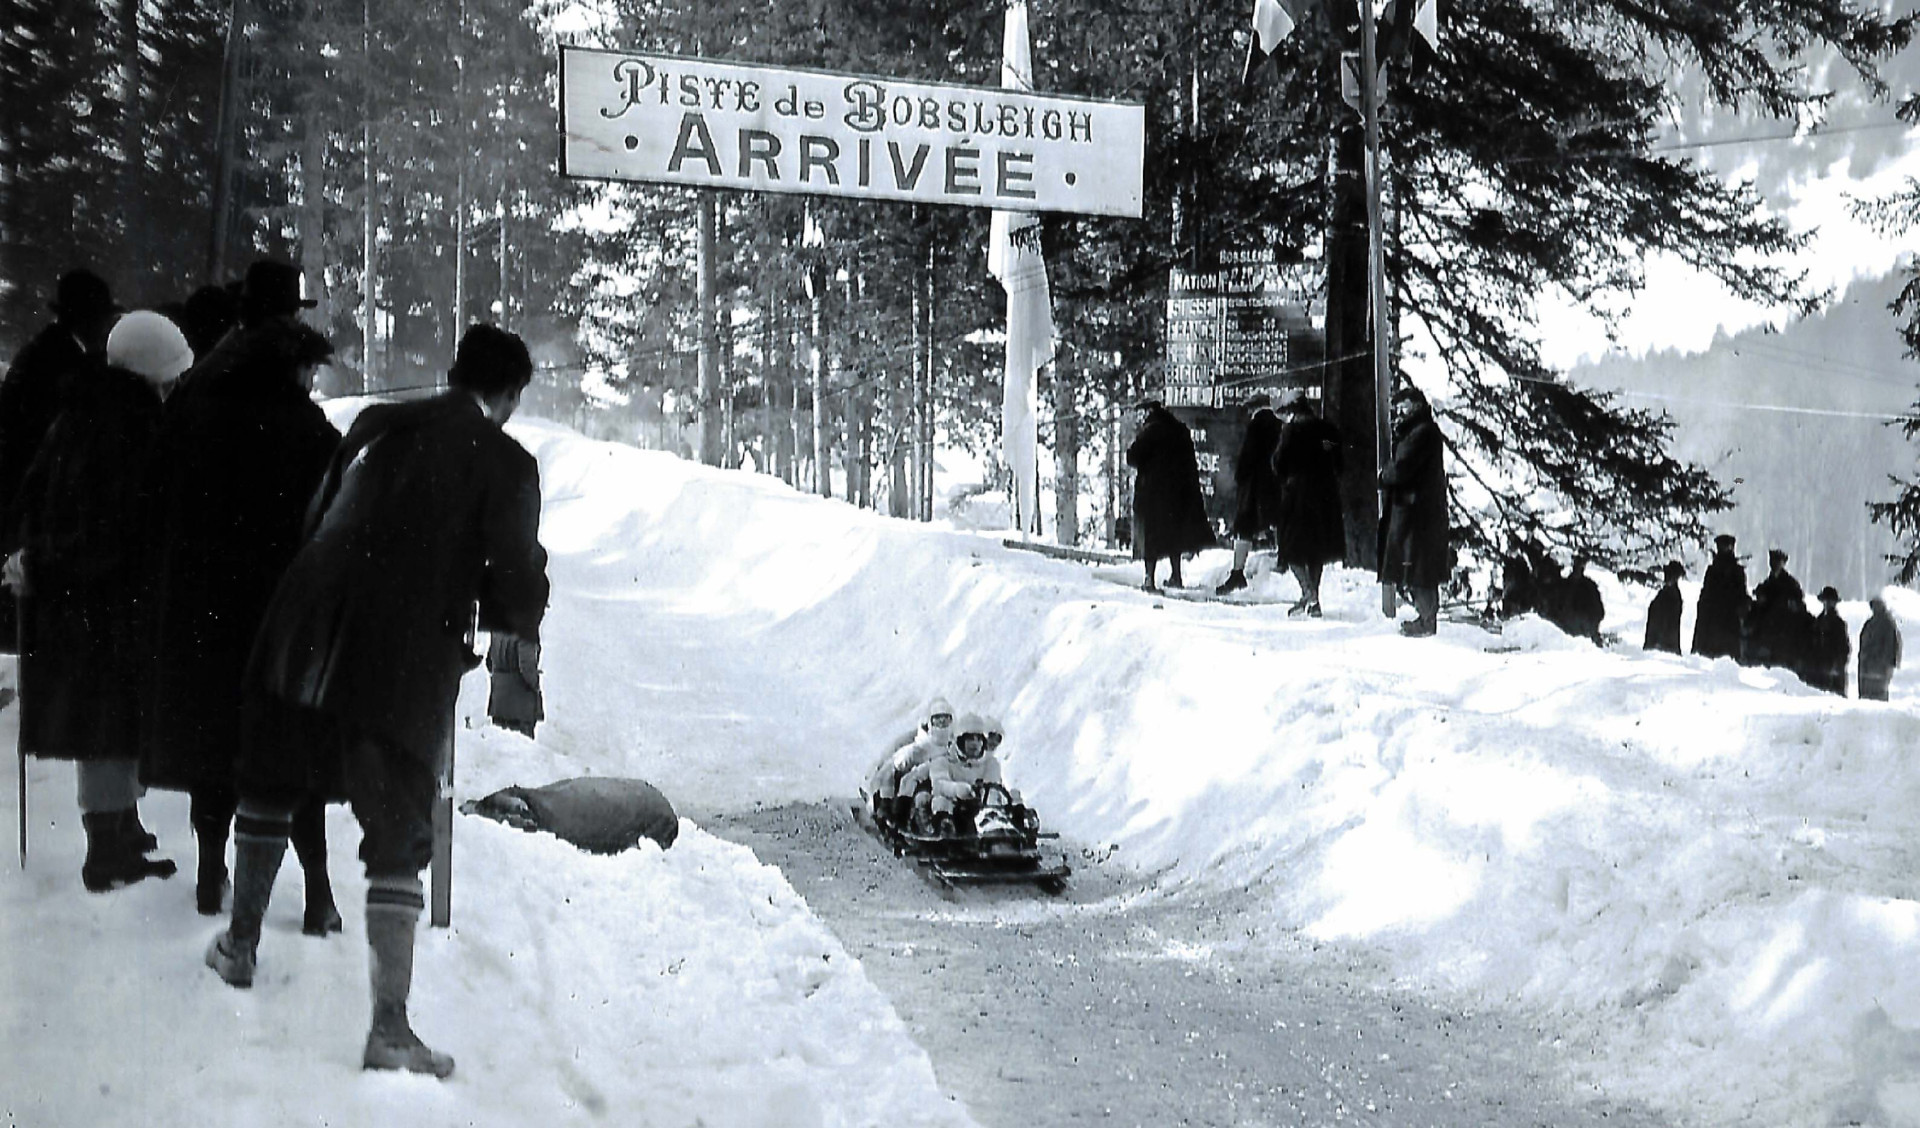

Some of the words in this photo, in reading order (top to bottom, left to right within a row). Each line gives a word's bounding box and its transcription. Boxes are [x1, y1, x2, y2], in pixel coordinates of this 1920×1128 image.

[775, 85, 825, 119] de
[843, 81, 1092, 143] BOBSLEIGH
[667, 112, 1036, 199] ARRIVÉE
